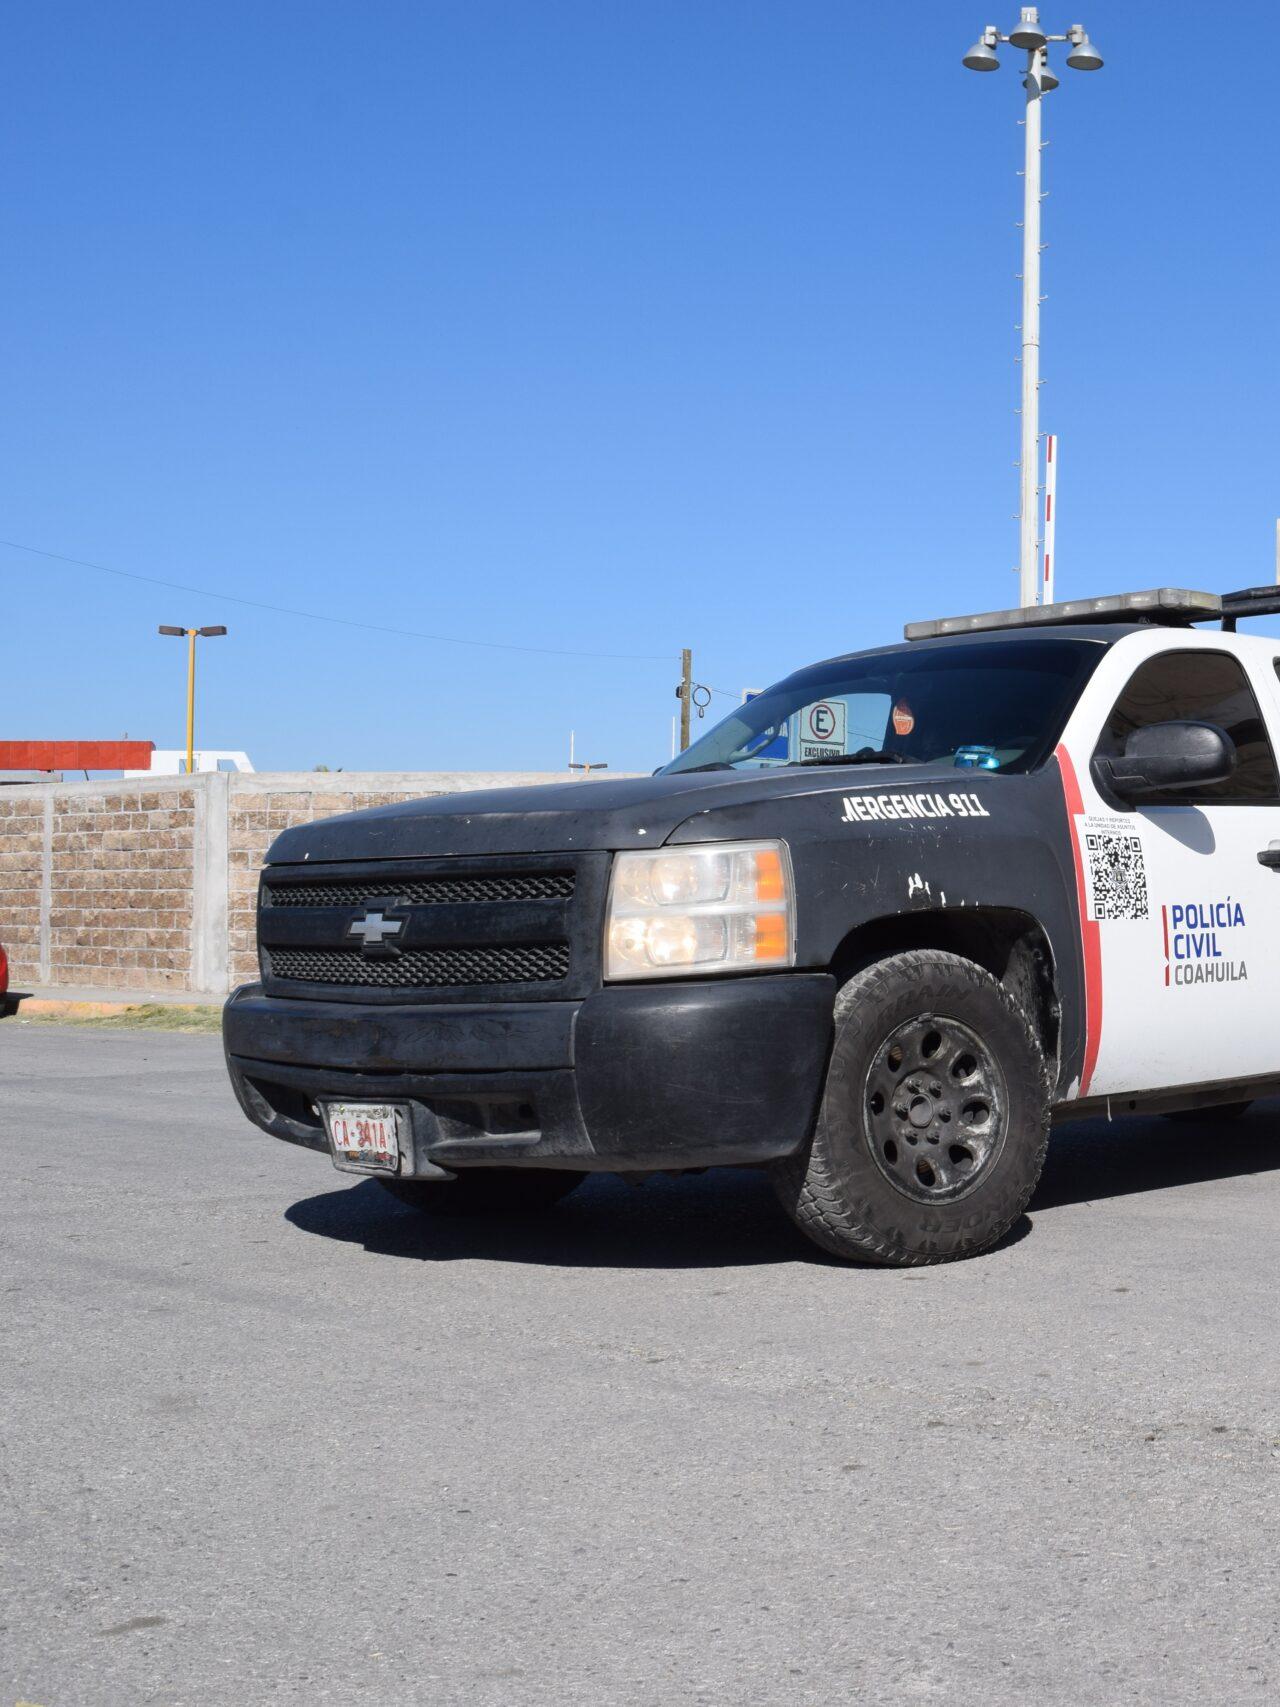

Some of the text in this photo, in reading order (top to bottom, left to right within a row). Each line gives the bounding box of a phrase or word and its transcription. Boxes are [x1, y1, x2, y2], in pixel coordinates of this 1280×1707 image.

[816, 709, 829, 733] E
[804, 746, 840, 758] EXCLUSIVO
[948, 793, 991, 817] 911
[1171, 896, 1246, 930] POLICÍA
[1173, 933, 1222, 960] CIVIL
[1174, 960, 1248, 986] COAHUILA
